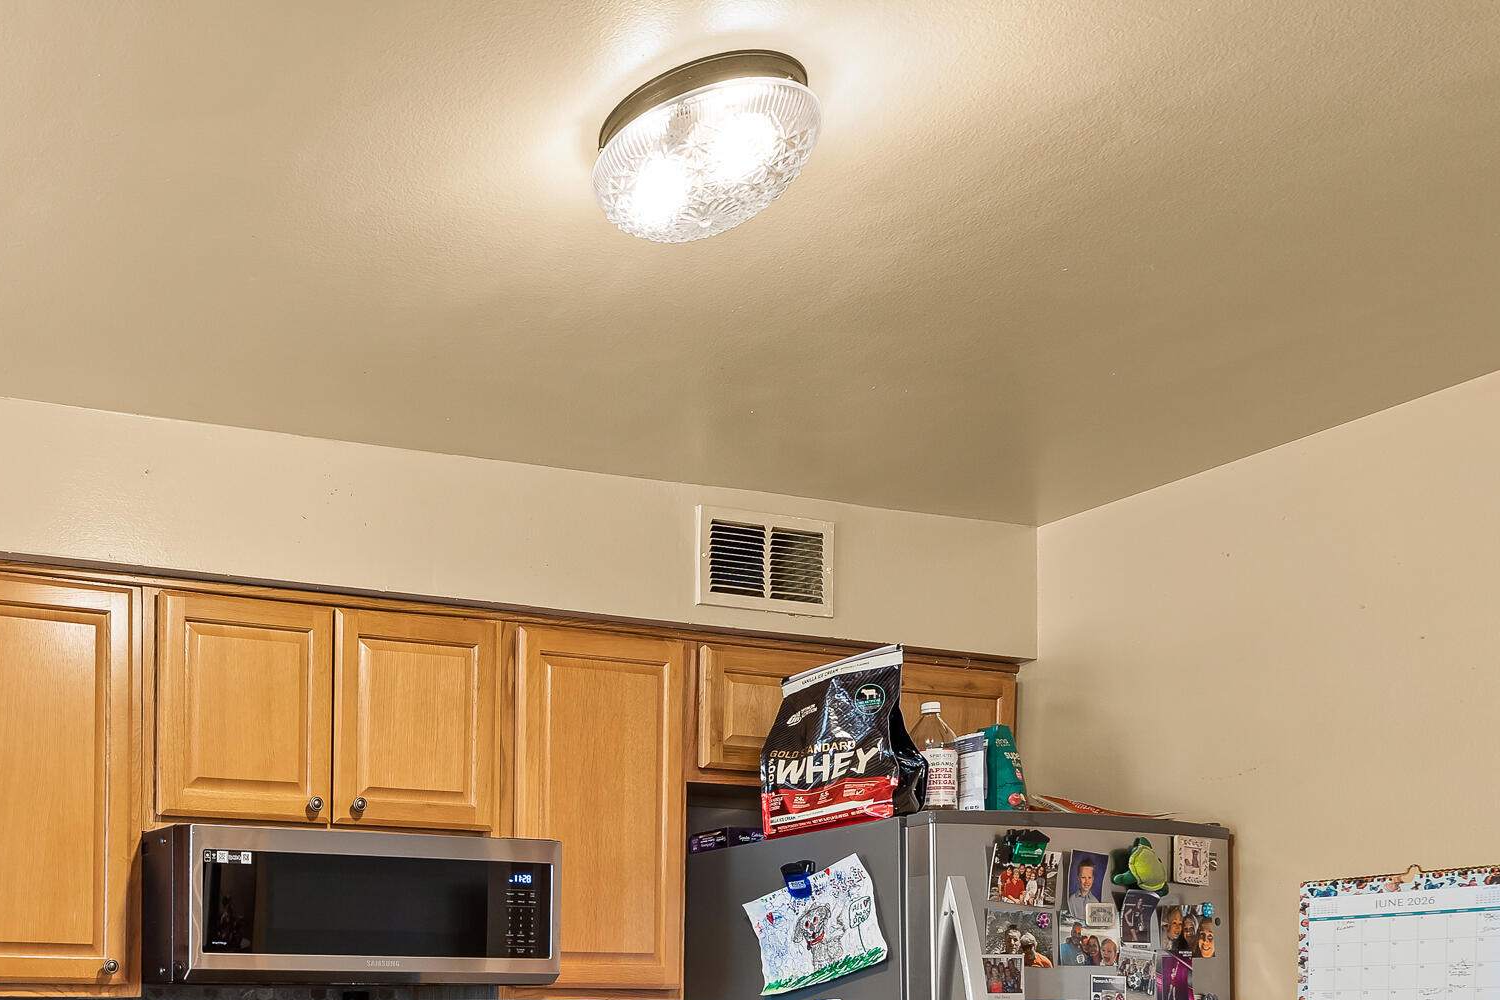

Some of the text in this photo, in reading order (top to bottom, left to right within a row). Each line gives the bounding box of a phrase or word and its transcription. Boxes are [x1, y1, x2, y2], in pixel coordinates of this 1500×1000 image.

[769, 740, 856, 759] GOLD ANDARD
[776, 747, 879, 785] WHEY
[1375, 896, 1435, 909] JUNE 2026
